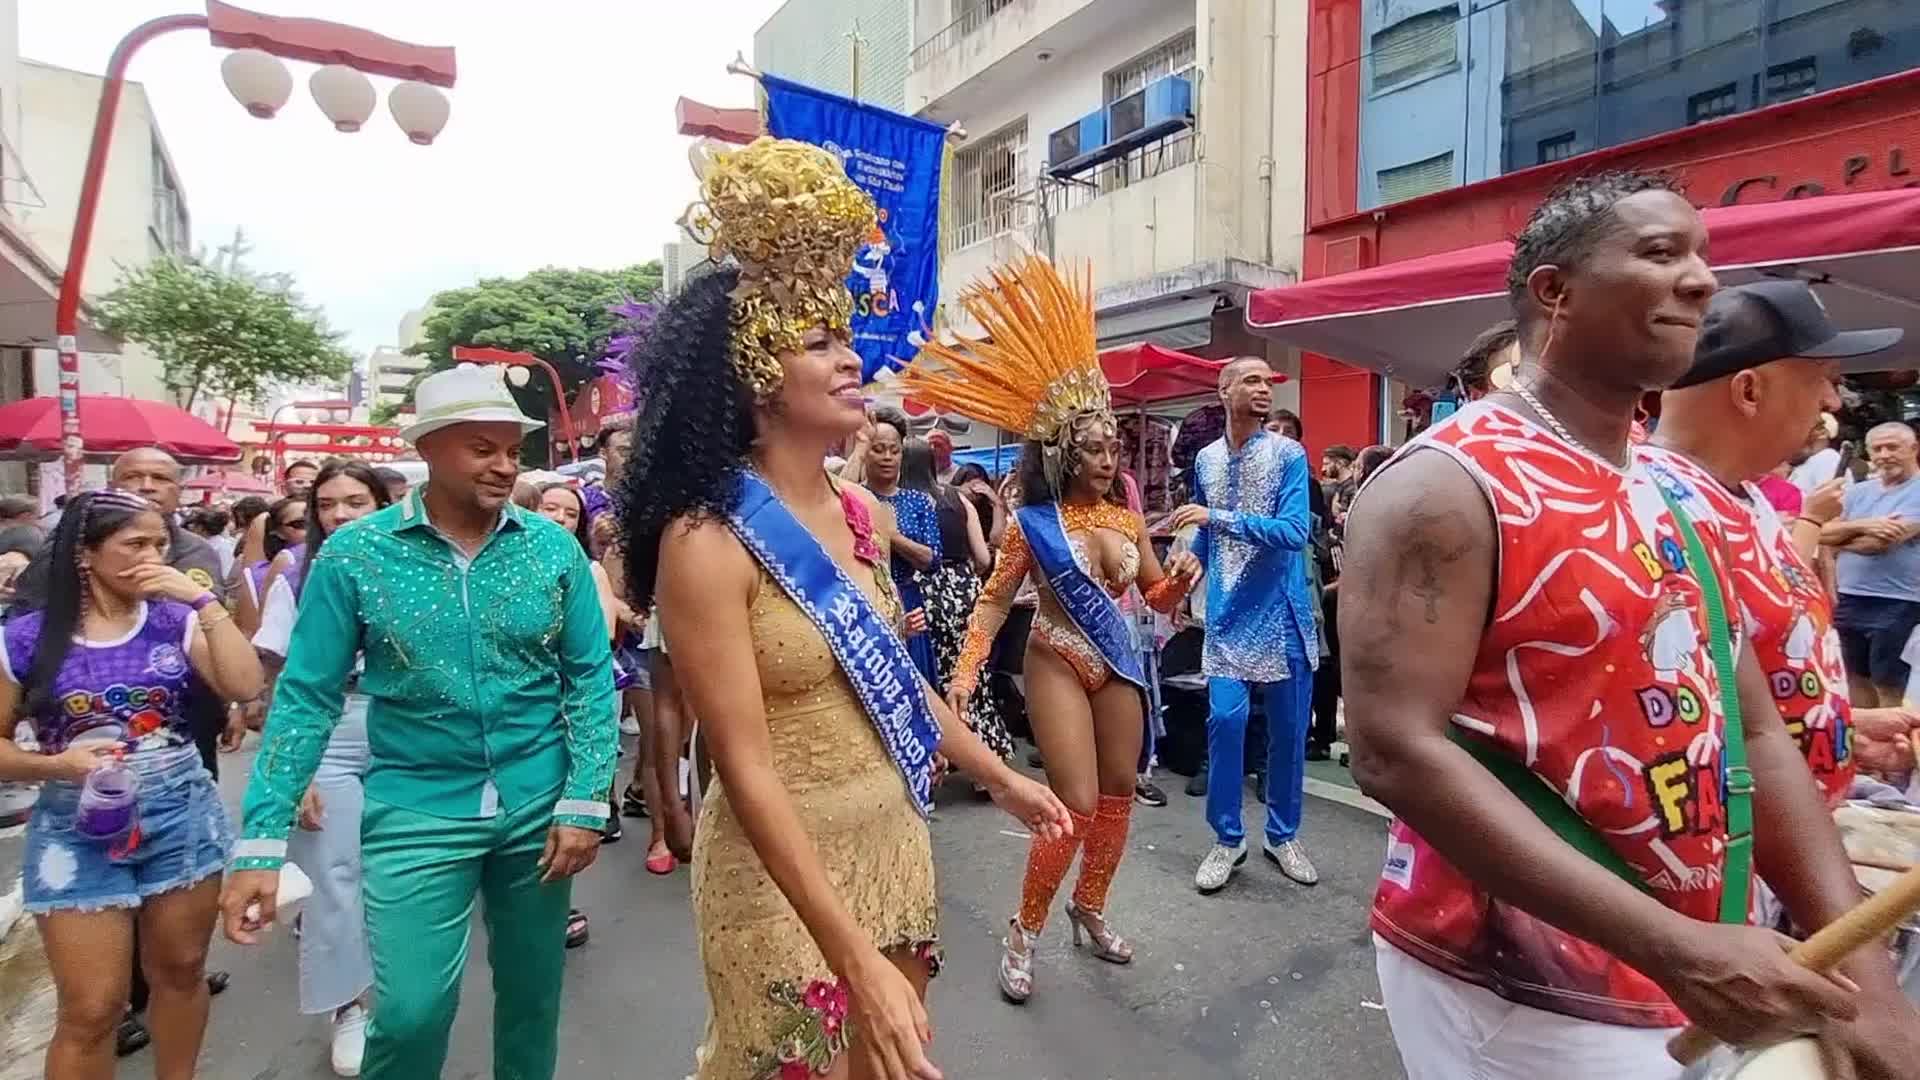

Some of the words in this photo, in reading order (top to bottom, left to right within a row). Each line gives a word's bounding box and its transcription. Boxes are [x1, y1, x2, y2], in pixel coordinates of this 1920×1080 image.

[856, 292, 900, 318] SCA
[828, 591, 903, 703] Rainha
[1772, 668, 1820, 700] DO
[64, 685, 168, 717] BLOCO
[1636, 685, 1703, 727] DO
